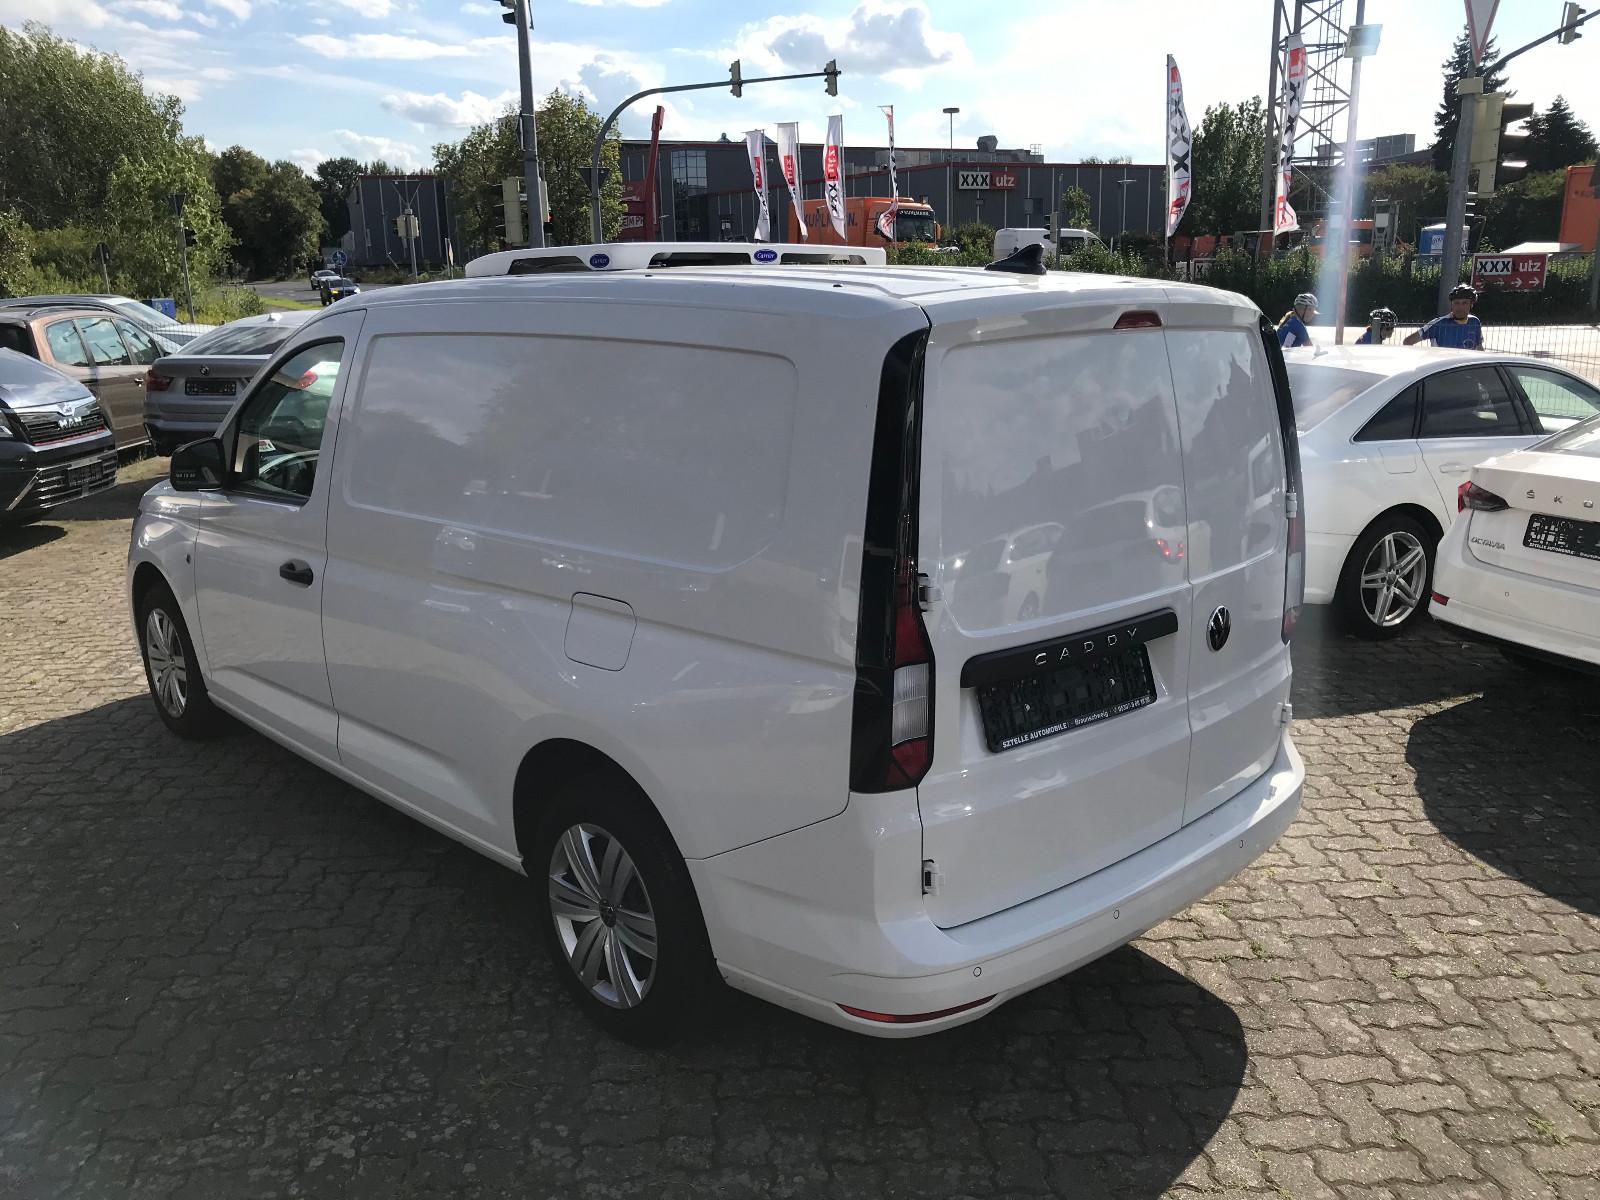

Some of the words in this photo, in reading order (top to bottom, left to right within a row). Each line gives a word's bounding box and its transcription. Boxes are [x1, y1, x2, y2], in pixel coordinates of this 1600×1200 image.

[58, 416, 82, 428] MAN
[1471, 536, 1506, 550] OCTAVIA
[1034, 628, 1137, 666] CADDY
[1002, 733, 1030, 749] SZTELLE
